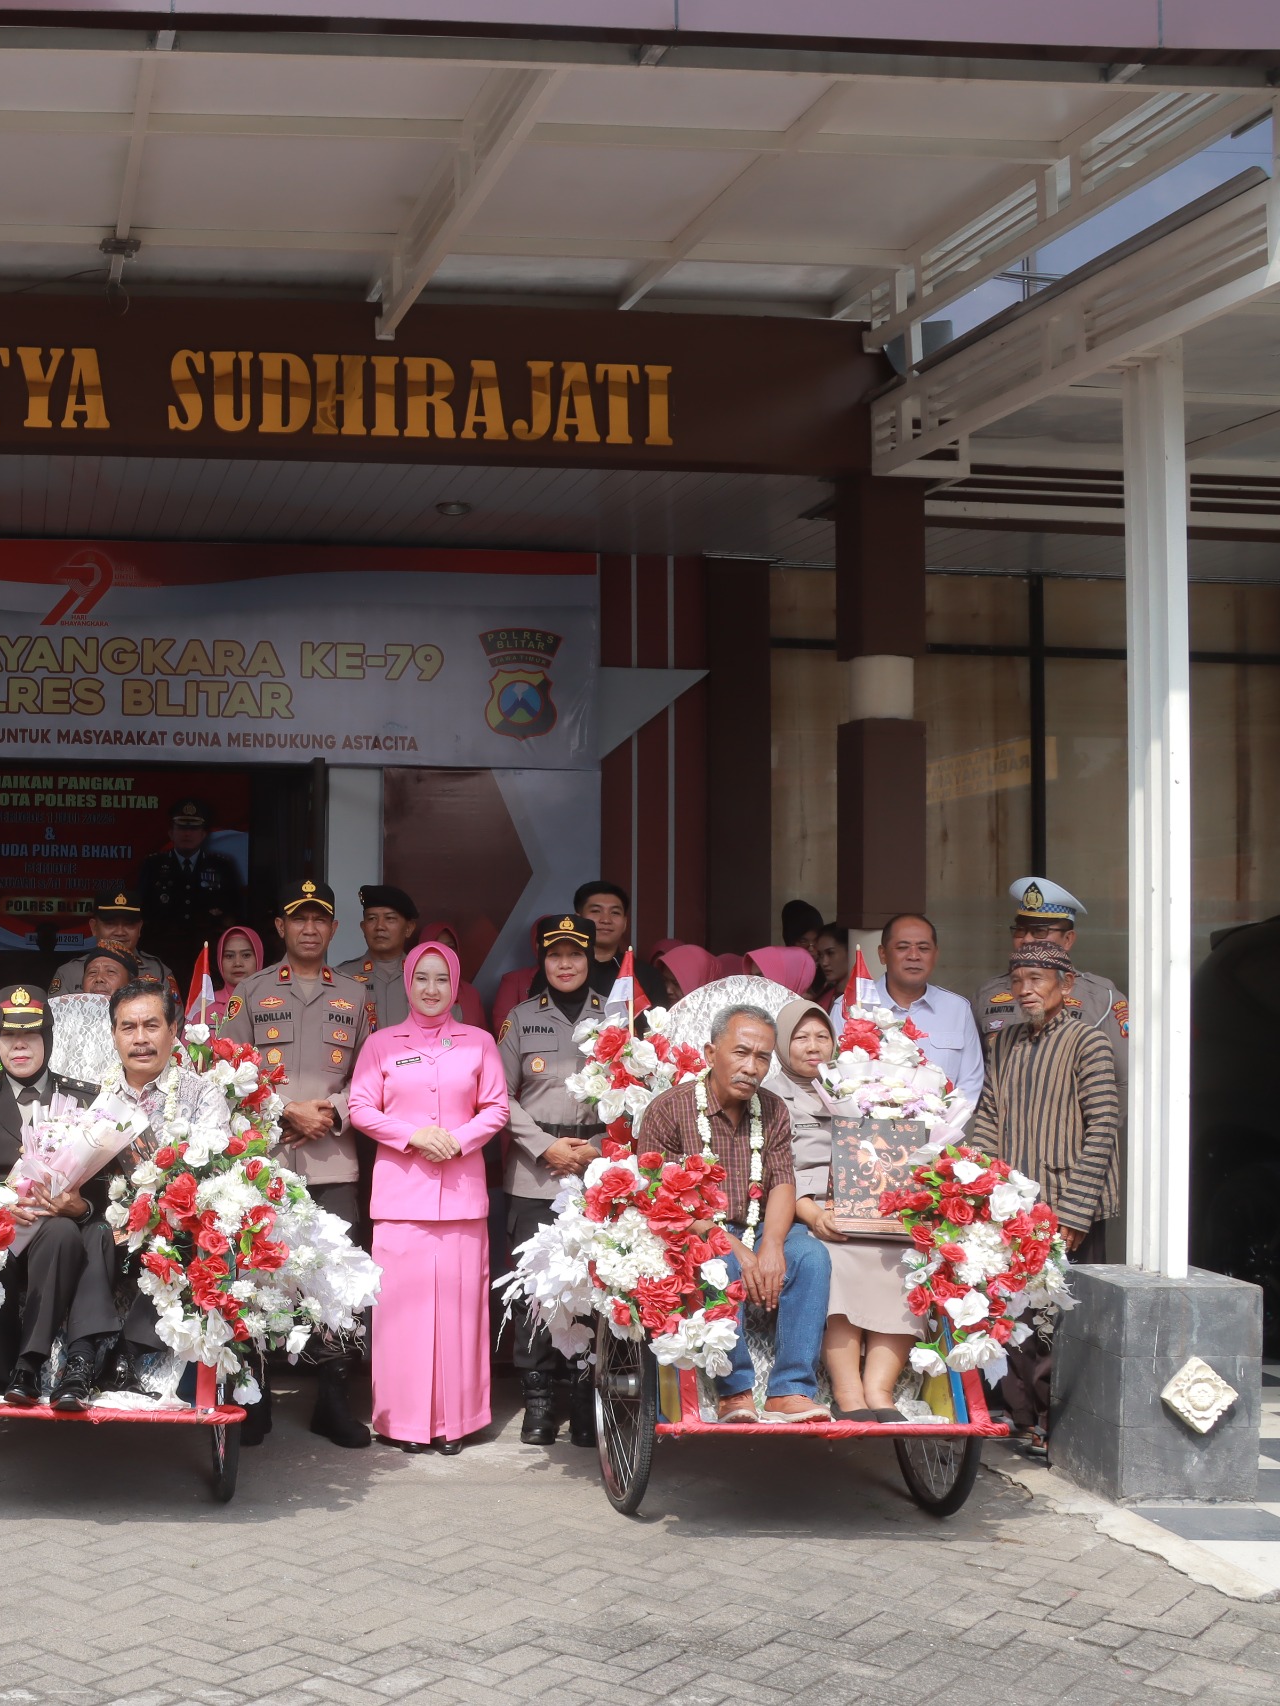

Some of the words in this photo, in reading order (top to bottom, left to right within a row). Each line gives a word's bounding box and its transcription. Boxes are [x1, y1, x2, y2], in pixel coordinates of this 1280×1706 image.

[168, 349, 674, 446] SUDHIRAJATI
[487, 631, 554, 644] POLRES
[496, 640, 545, 651] BLITAR
[300, 641, 444, 682] KE-79
[121, 678, 295, 719] BLITAR
[57, 729, 167, 746] MASYARAKAT
[172, 731, 222, 747] GUNA
[227, 732, 337, 750] MENDUKUNG
[342, 735, 418, 751] ASTACITA
[58, 776, 135, 791] PANGKAT
[34, 794, 97, 808] POLRES
[101, 795, 159, 809] BLITAR
[44, 827, 56, 840] &
[32, 844, 78, 858] PURNA
[81, 845, 132, 859] BHAKTI
[5, 900, 54, 912] POLRES
[57, 901, 94, 913] BLITA
[254, 1011, 292, 1023] FADILLAH
[328, 1013, 354, 1025] POLRI
[522, 1025, 555, 1034] WIRNA
